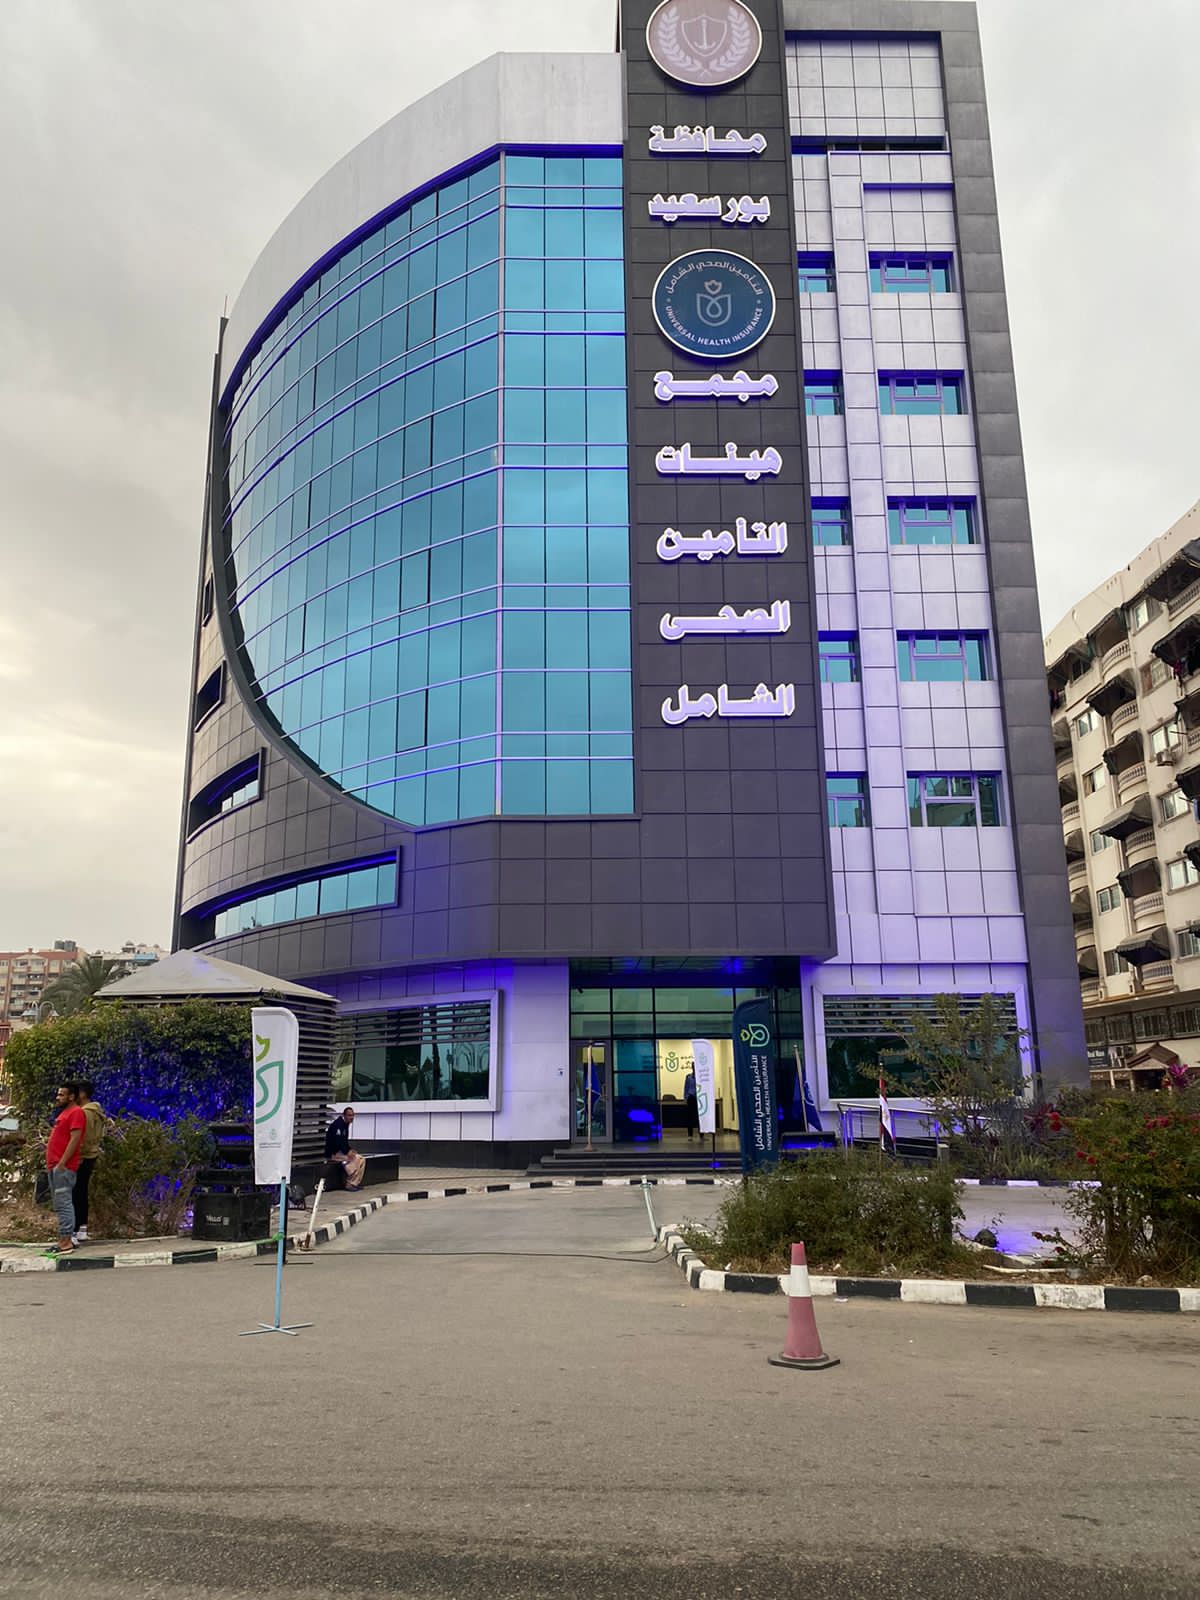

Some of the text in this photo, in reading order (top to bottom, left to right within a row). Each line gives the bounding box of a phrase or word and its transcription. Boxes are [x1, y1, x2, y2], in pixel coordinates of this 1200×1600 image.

[648, 125, 767, 153] محافظة
[665, 263, 695, 294] الشامل
[665, 305, 763, 346] UNIVERSAL HEALTH INSURANCE
[654, 371, 778, 402] مجمع
[662, 683, 795, 724] الشامل
[761, 1055, 769, 1089] INSURANCE
[753, 1119, 765, 1150] الشامل
